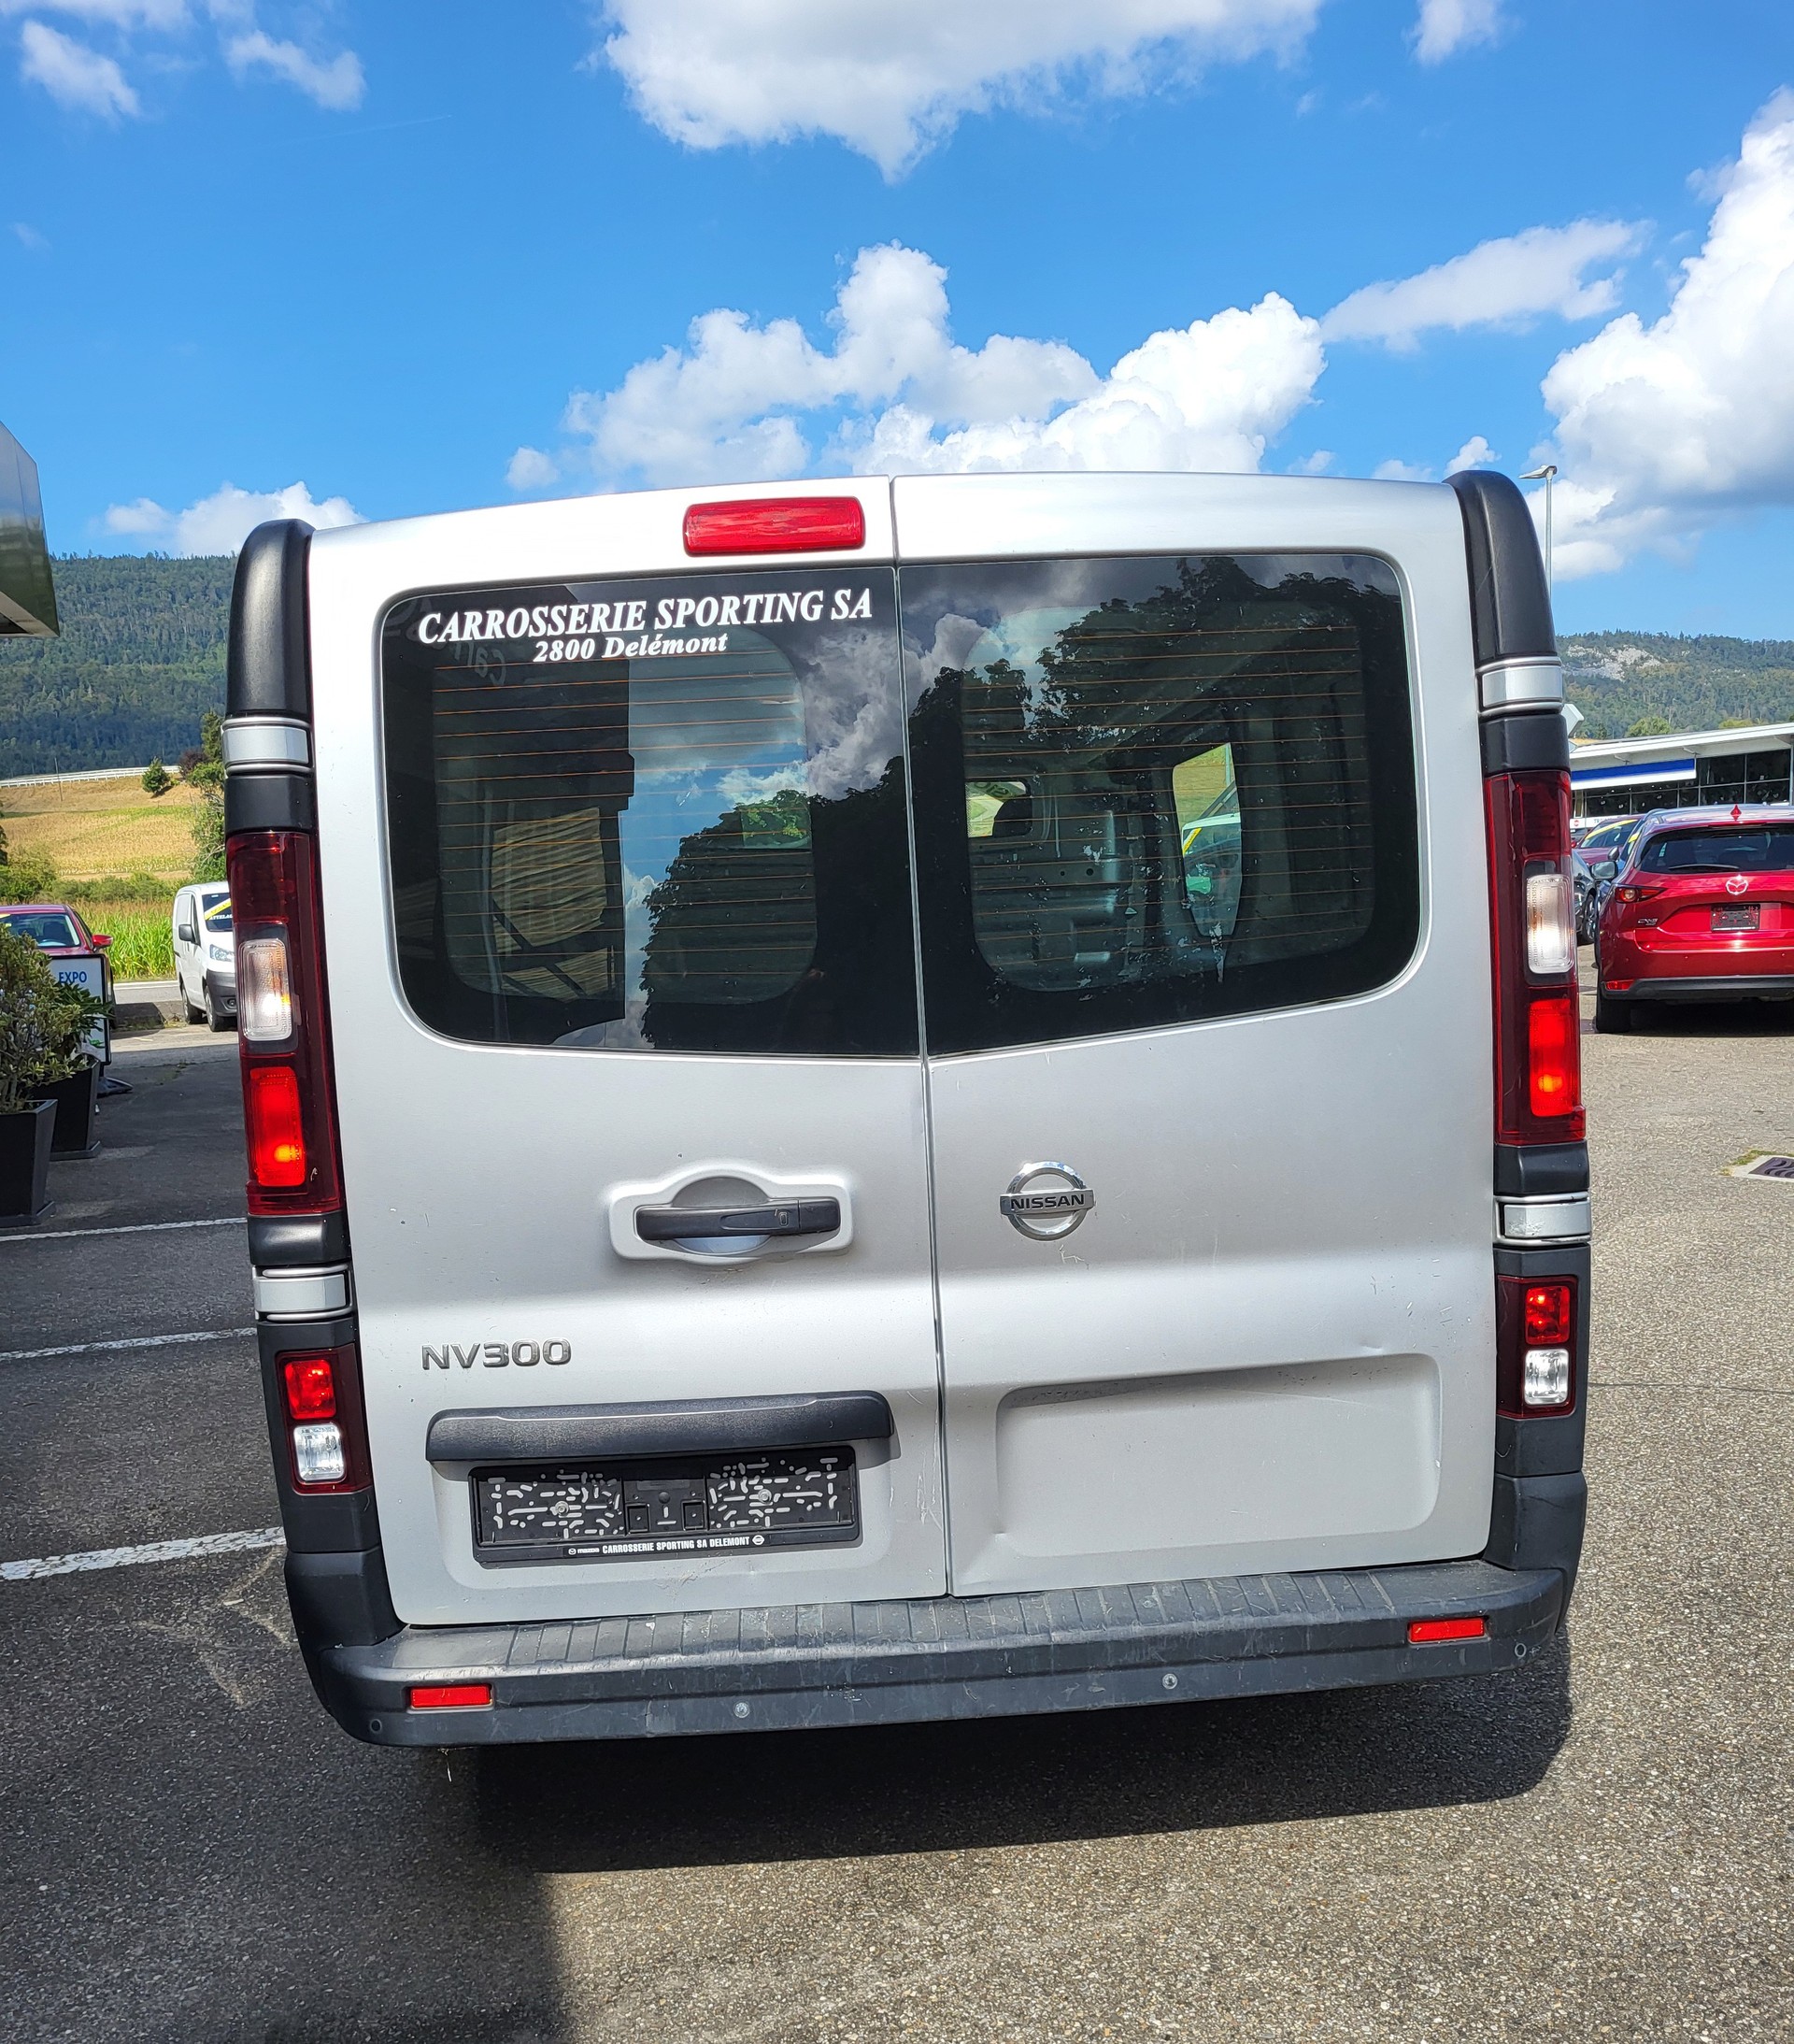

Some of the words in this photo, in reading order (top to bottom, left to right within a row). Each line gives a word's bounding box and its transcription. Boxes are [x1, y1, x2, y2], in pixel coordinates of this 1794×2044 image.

[419, 600, 647, 644] CARROSSERIE
[654, 590, 824, 631] SPORTING
[831, 588, 874, 620] SA
[533, 637, 596, 663] 2800
[601, 633, 729, 659] Delémont
[58, 971, 88, 983] EXPO
[1010, 1194, 1085, 1210] NISSAN
[421, 1338, 573, 1371] NV300
[602, 1542, 655, 1554] CARROSSERIE
[656, 1539, 695, 1551] SPORTING
[696, 1538, 708, 1549] SA
[709, 1536, 750, 1548] DELEMONT
